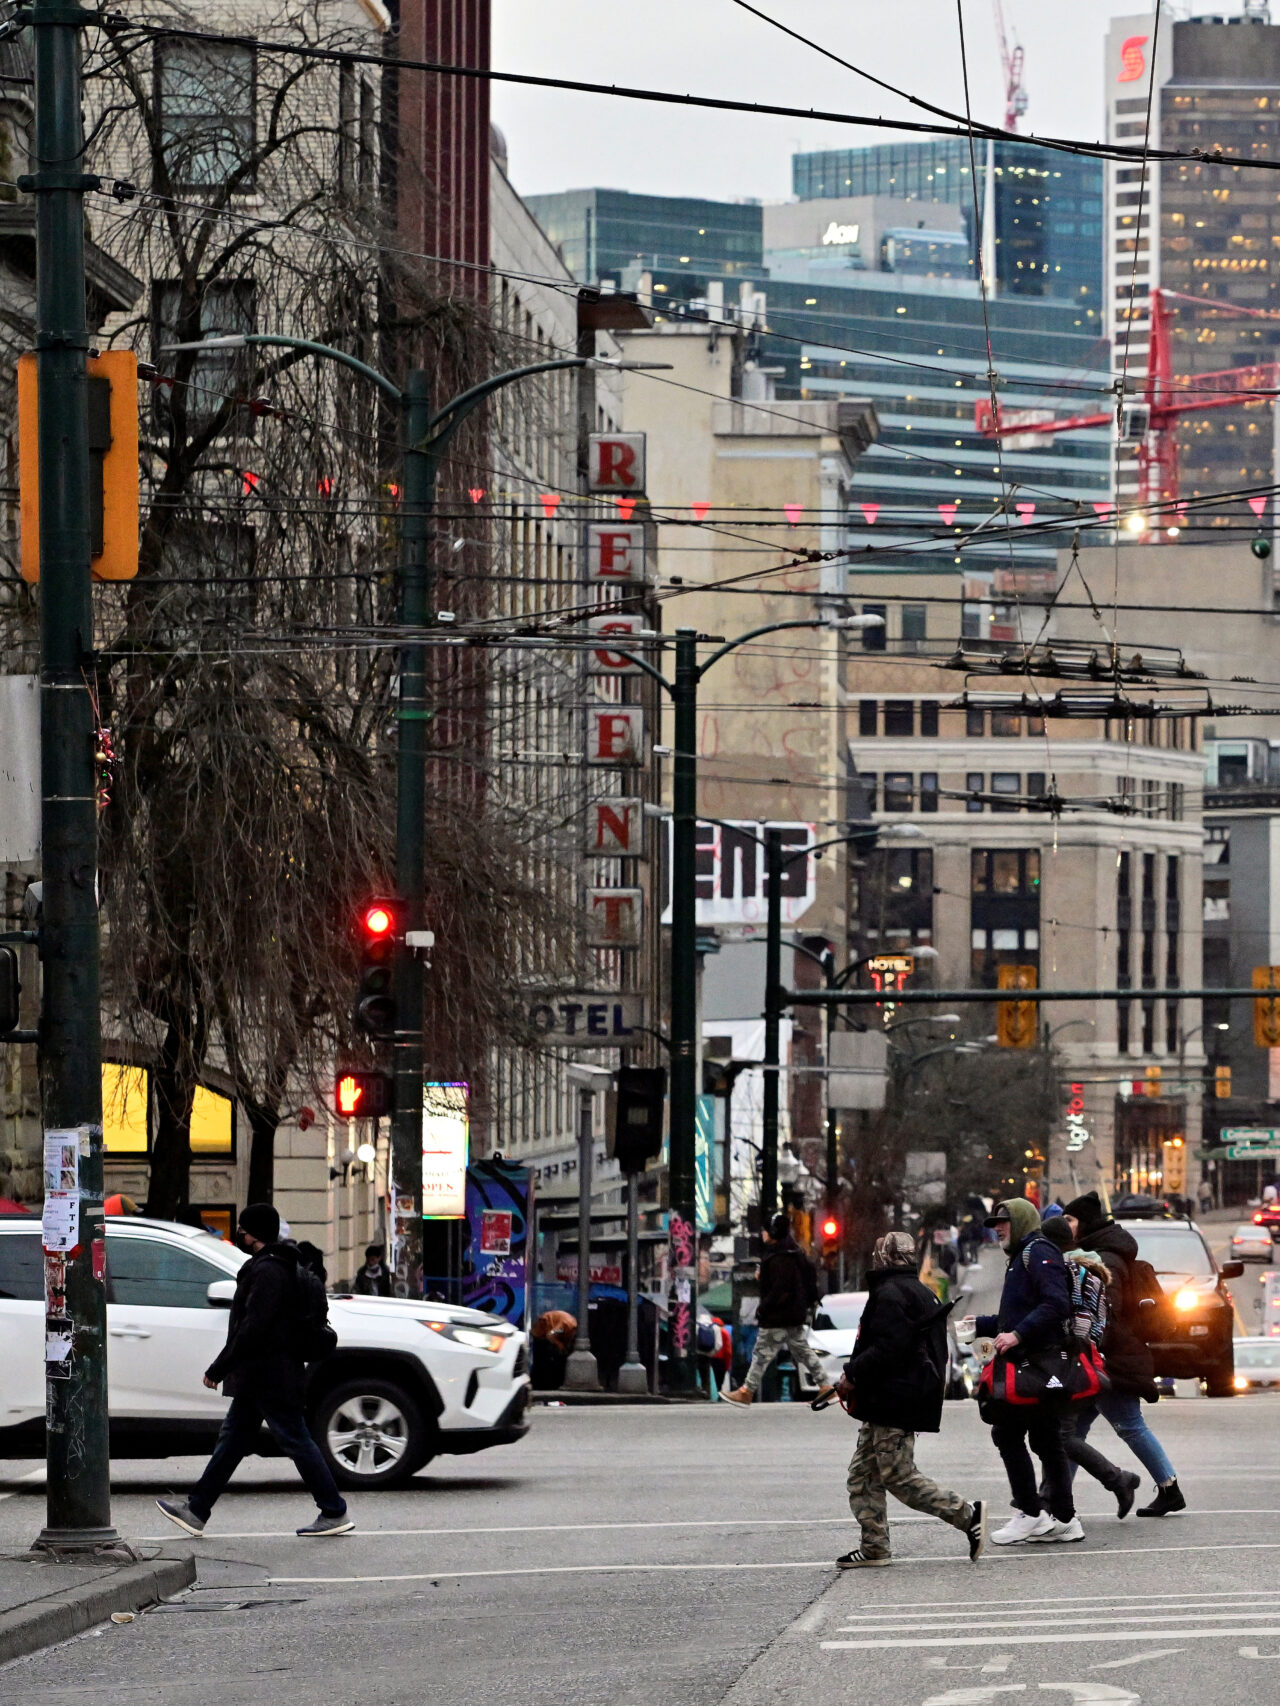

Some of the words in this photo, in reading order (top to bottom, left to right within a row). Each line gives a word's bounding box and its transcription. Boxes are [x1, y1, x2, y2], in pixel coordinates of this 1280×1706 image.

[594, 440, 637, 942] REGENT
[868, 959, 911, 971] HOTEL
[528, 1003, 634, 1037] OTEL
